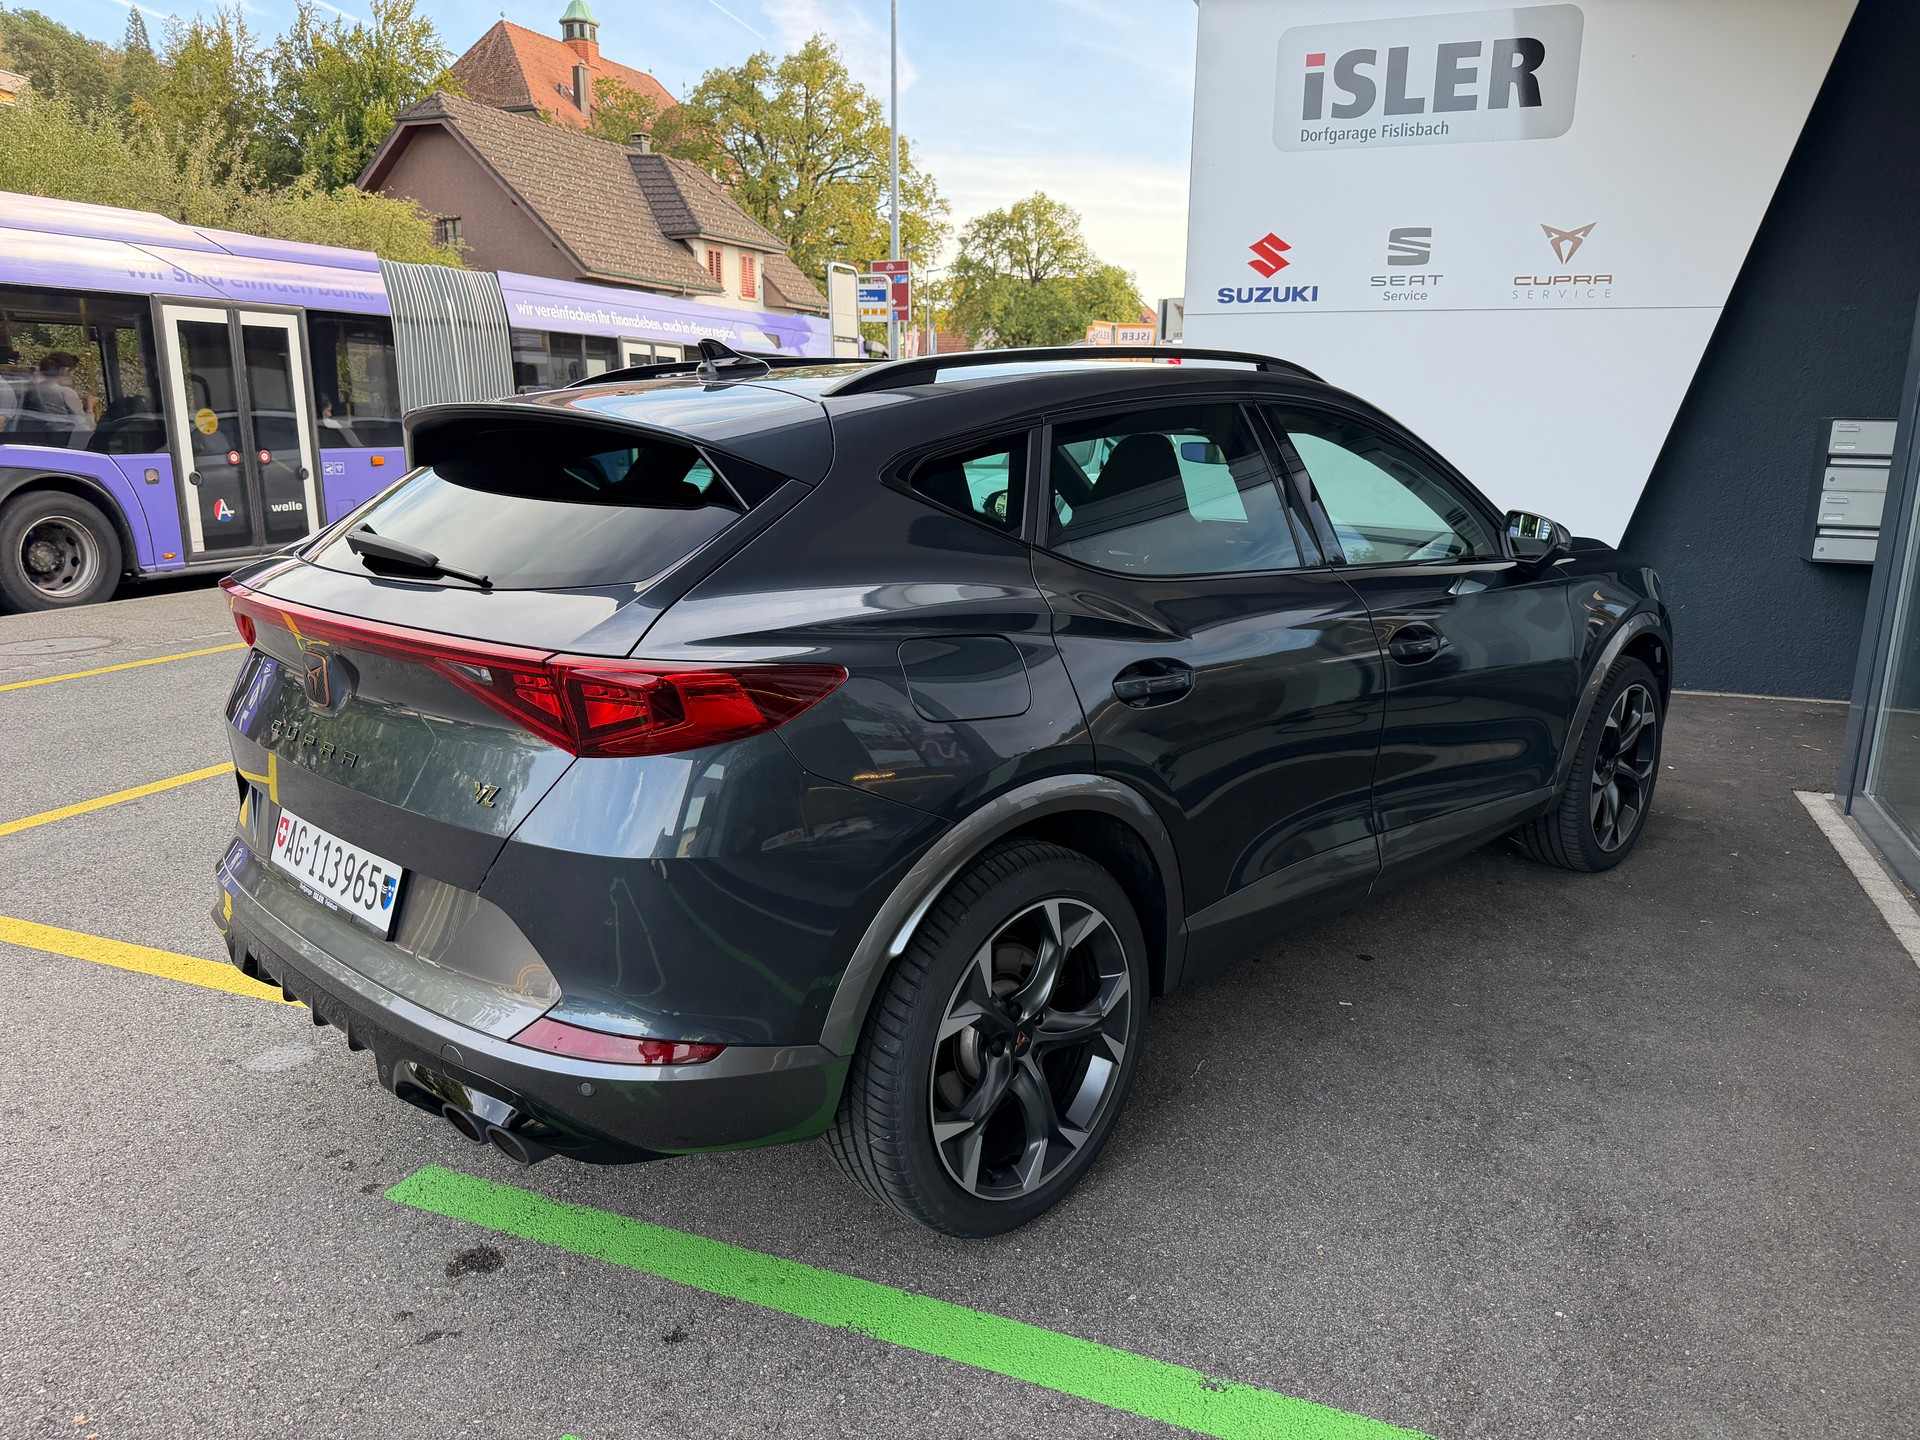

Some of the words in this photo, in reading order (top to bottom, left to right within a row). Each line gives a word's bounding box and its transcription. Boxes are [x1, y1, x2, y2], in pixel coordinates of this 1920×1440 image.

[1300, 125, 1377, 145] Dorfgarage
[1381, 120, 1449, 139] Fislisbach
[172, 265, 225, 286] sind
[1370, 273, 1444, 287] SEAT
[1513, 273, 1613, 287] CUPRA
[1216, 285, 1319, 304] SUZUKI
[1382, 290, 1428, 302] Service
[1511, 288, 1613, 300] SERVICE
[515, 300, 534, 316] wir
[534, 304, 598, 323] vereinfachen
[598, 309, 611, 325] ihr
[611, 311, 663, 331] finanzleben.
[663, 319, 682, 334] auch
[682, 323, 690, 335] in
[690, 321, 714, 338] dieser
[271, 500, 303, 513] welle
[270, 719, 359, 768] CUPRA
